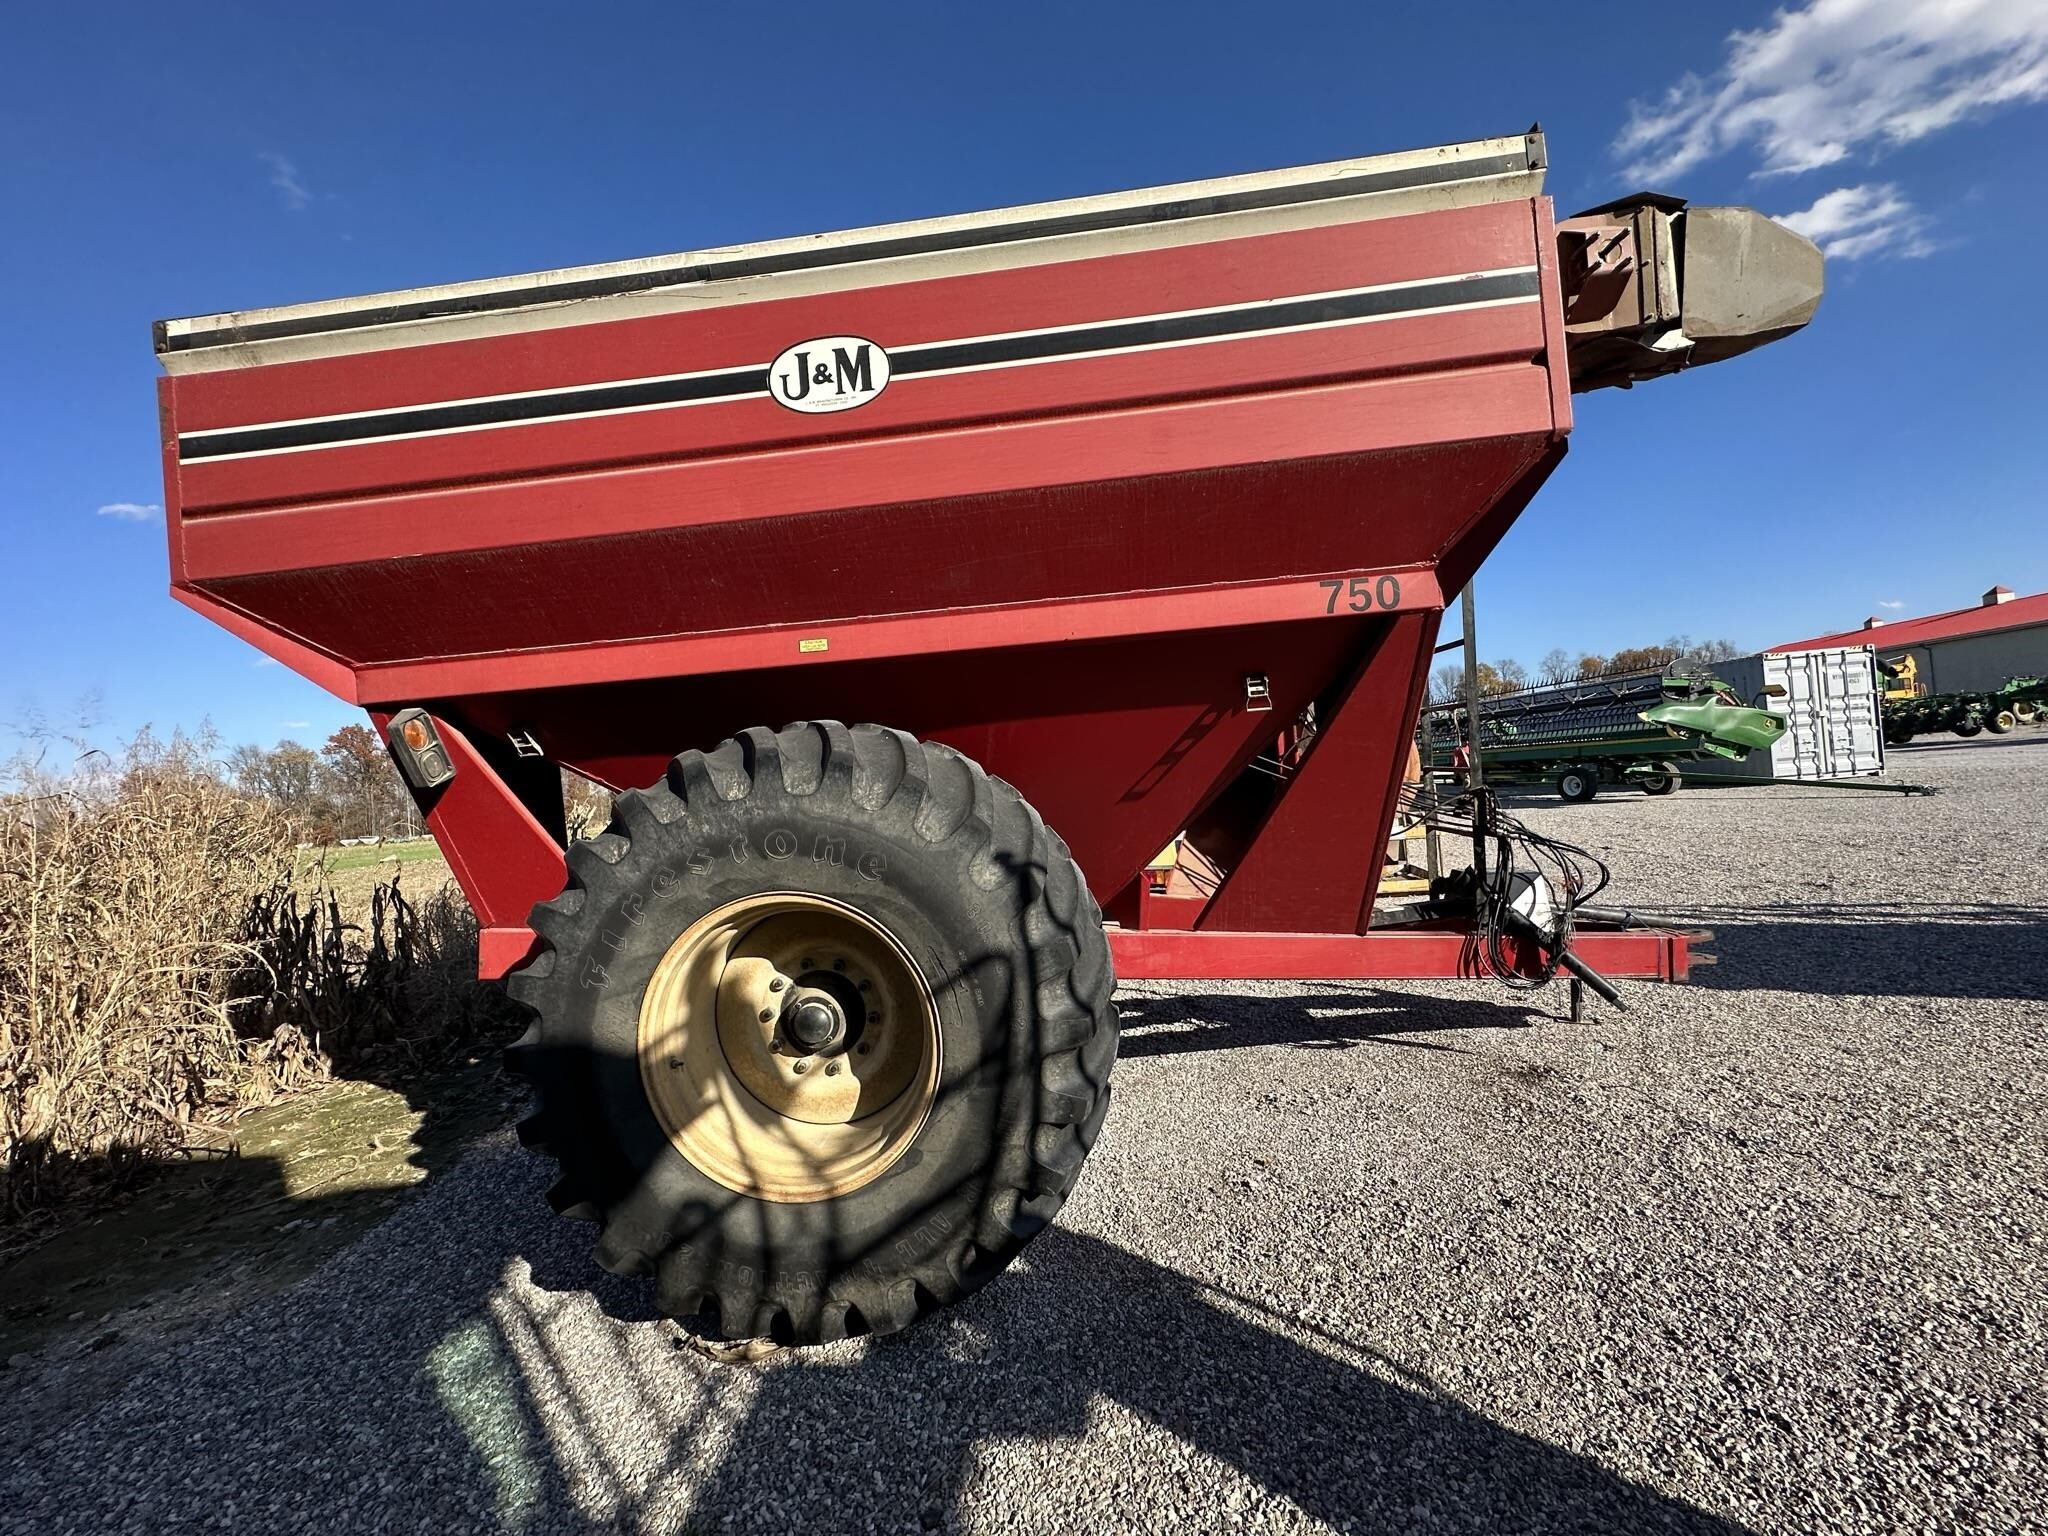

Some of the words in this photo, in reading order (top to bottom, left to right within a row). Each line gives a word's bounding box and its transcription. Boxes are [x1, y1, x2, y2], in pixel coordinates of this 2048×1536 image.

[779, 345, 875, 401] J&M
[1320, 576, 1400, 614] 750
[580, 830, 887, 990] Firestone
